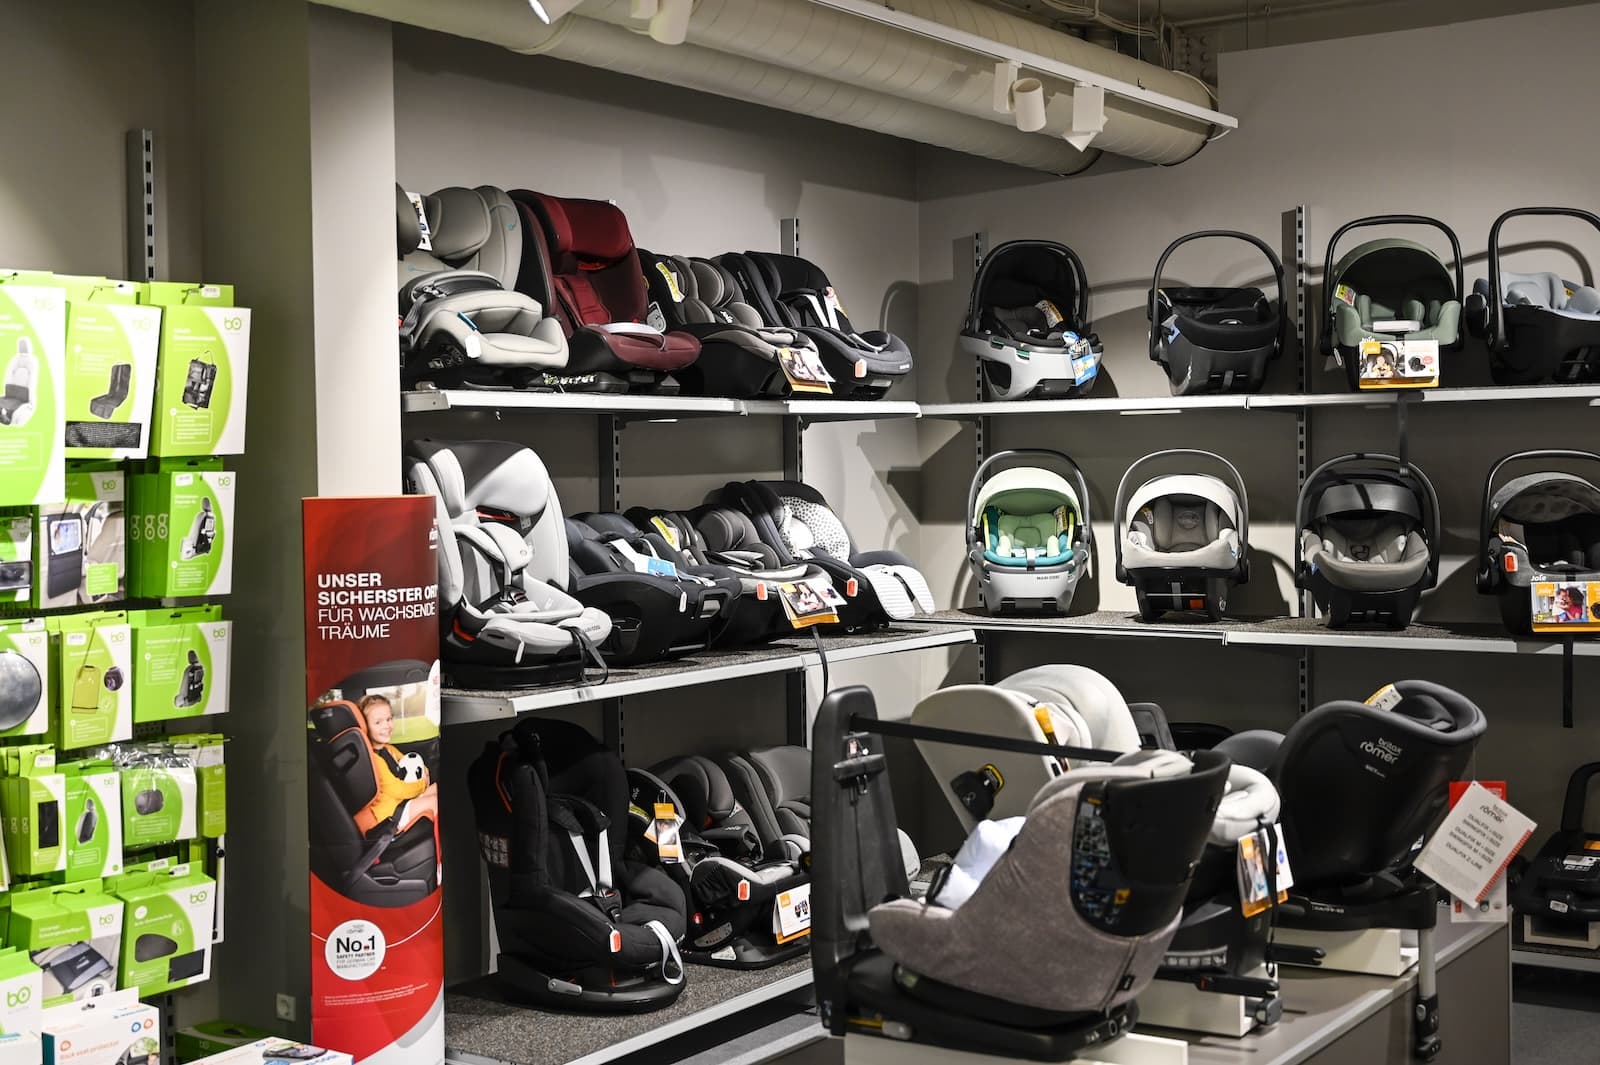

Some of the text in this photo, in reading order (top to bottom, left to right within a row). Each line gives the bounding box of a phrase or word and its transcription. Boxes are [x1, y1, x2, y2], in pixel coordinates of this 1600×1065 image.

[317, 572, 382, 588] UNSER
[317, 587, 422, 606] SICHERSTER
[318, 601, 436, 623] FÜR WACHSENDE
[317, 622, 390, 641] TRÄUME
[1360, 741, 1398, 764] römer
[1378, 738, 1401, 754] britax
